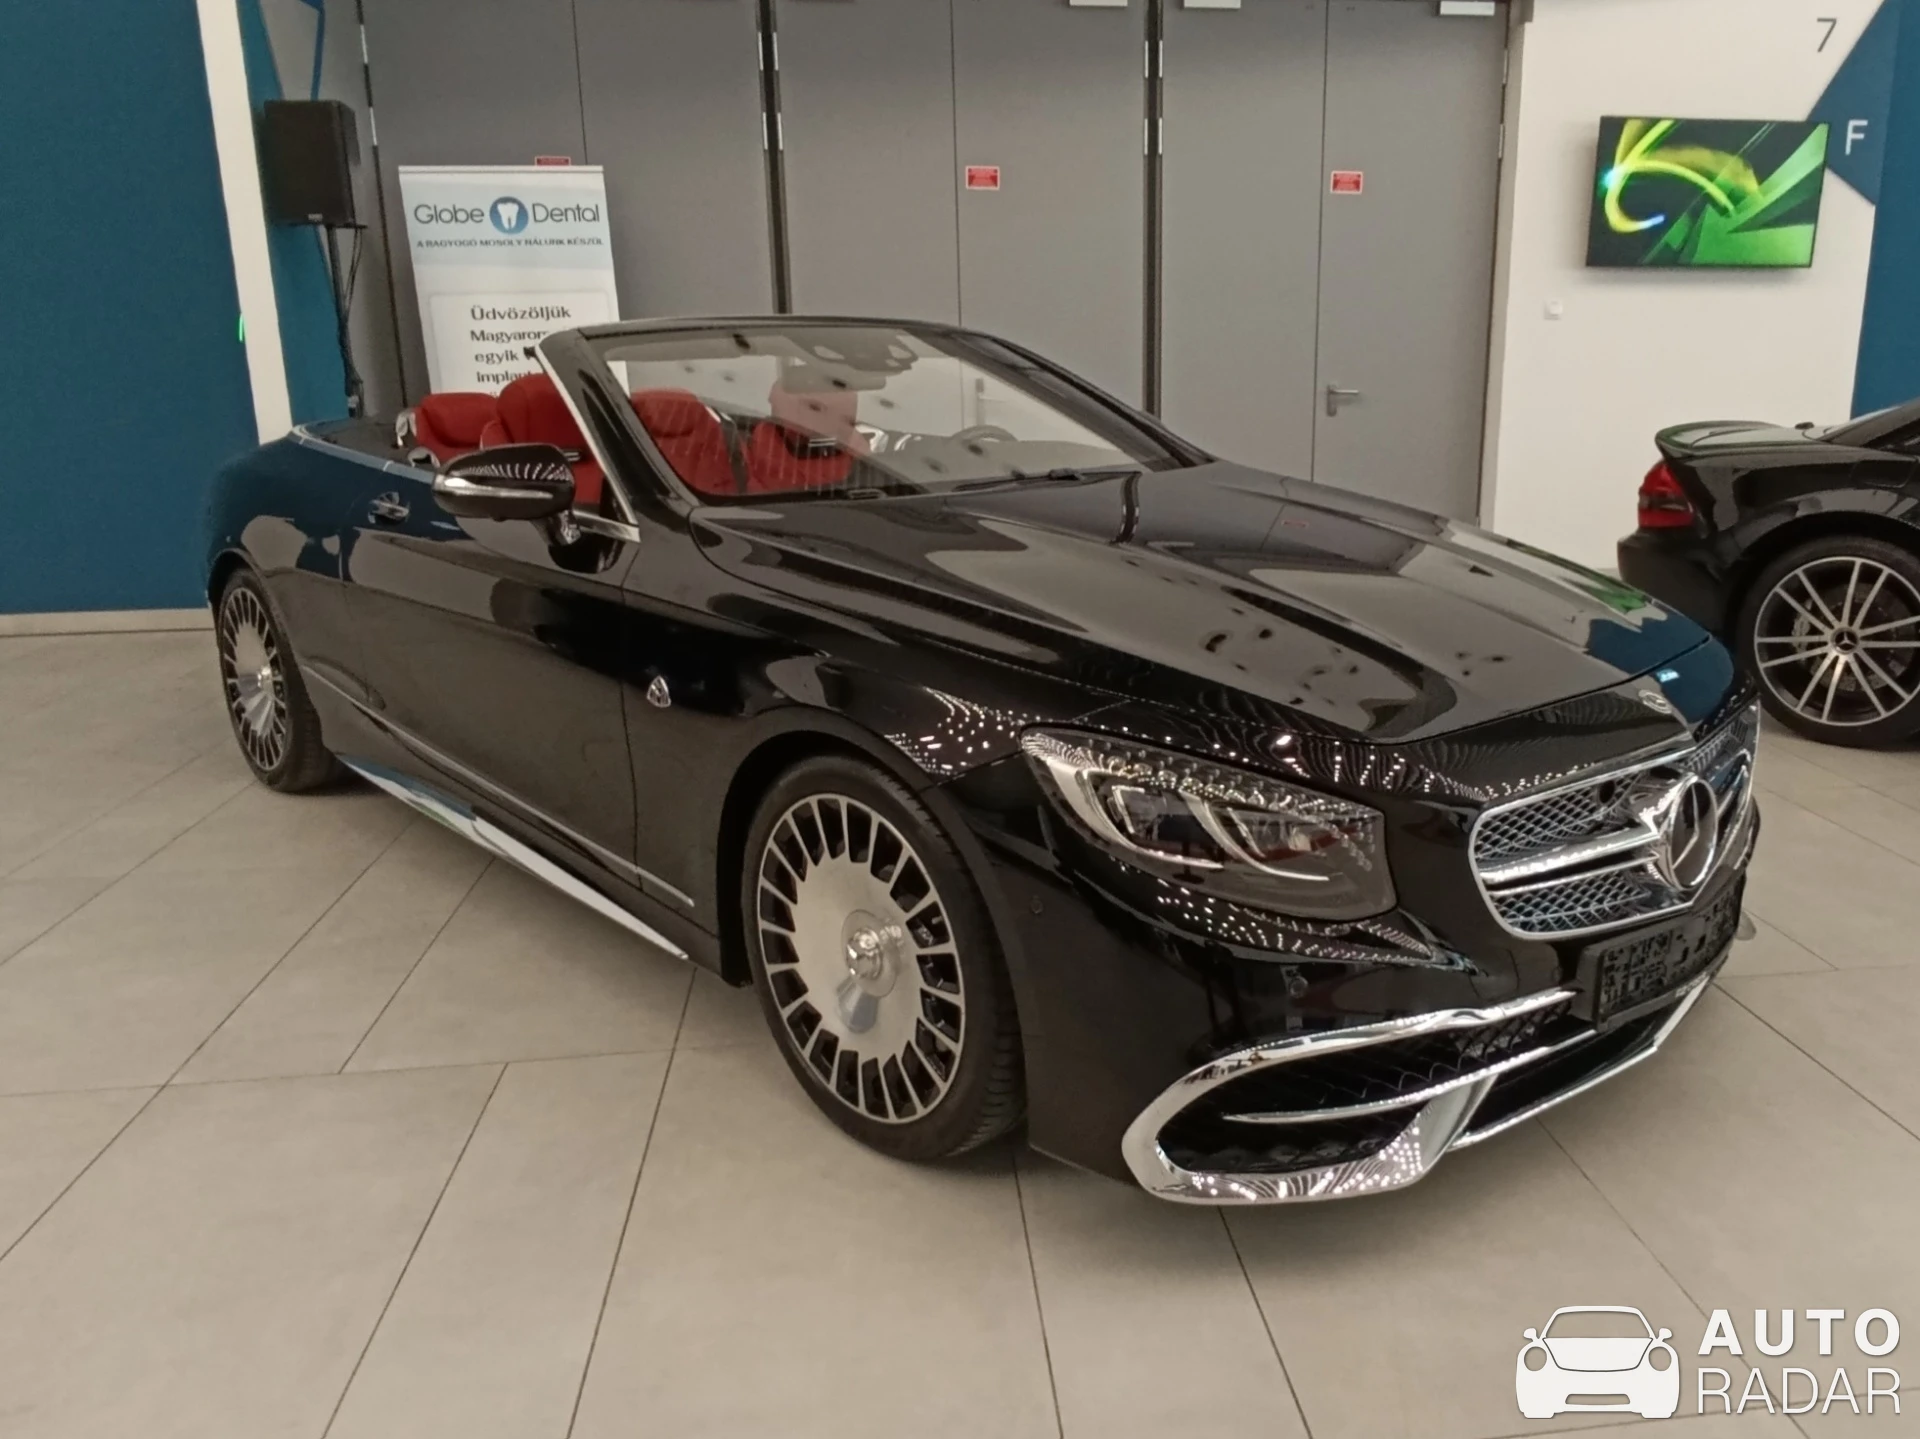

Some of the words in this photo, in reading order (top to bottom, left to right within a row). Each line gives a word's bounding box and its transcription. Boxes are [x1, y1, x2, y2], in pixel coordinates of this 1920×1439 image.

[1816, 18, 1837, 52] 7
[1845, 119, 1868, 155] F
[413, 203, 485, 225] Globe
[532, 202, 600, 224] Dental
[416, 239, 424, 248] A
[479, 238, 523, 248] MOSOLY
[525, 237, 565, 247] NÁLUNK
[470, 305, 572, 321] Üdvözöljük
[470, 329, 549, 344] Magyaror
[474, 350, 519, 365] egyik
